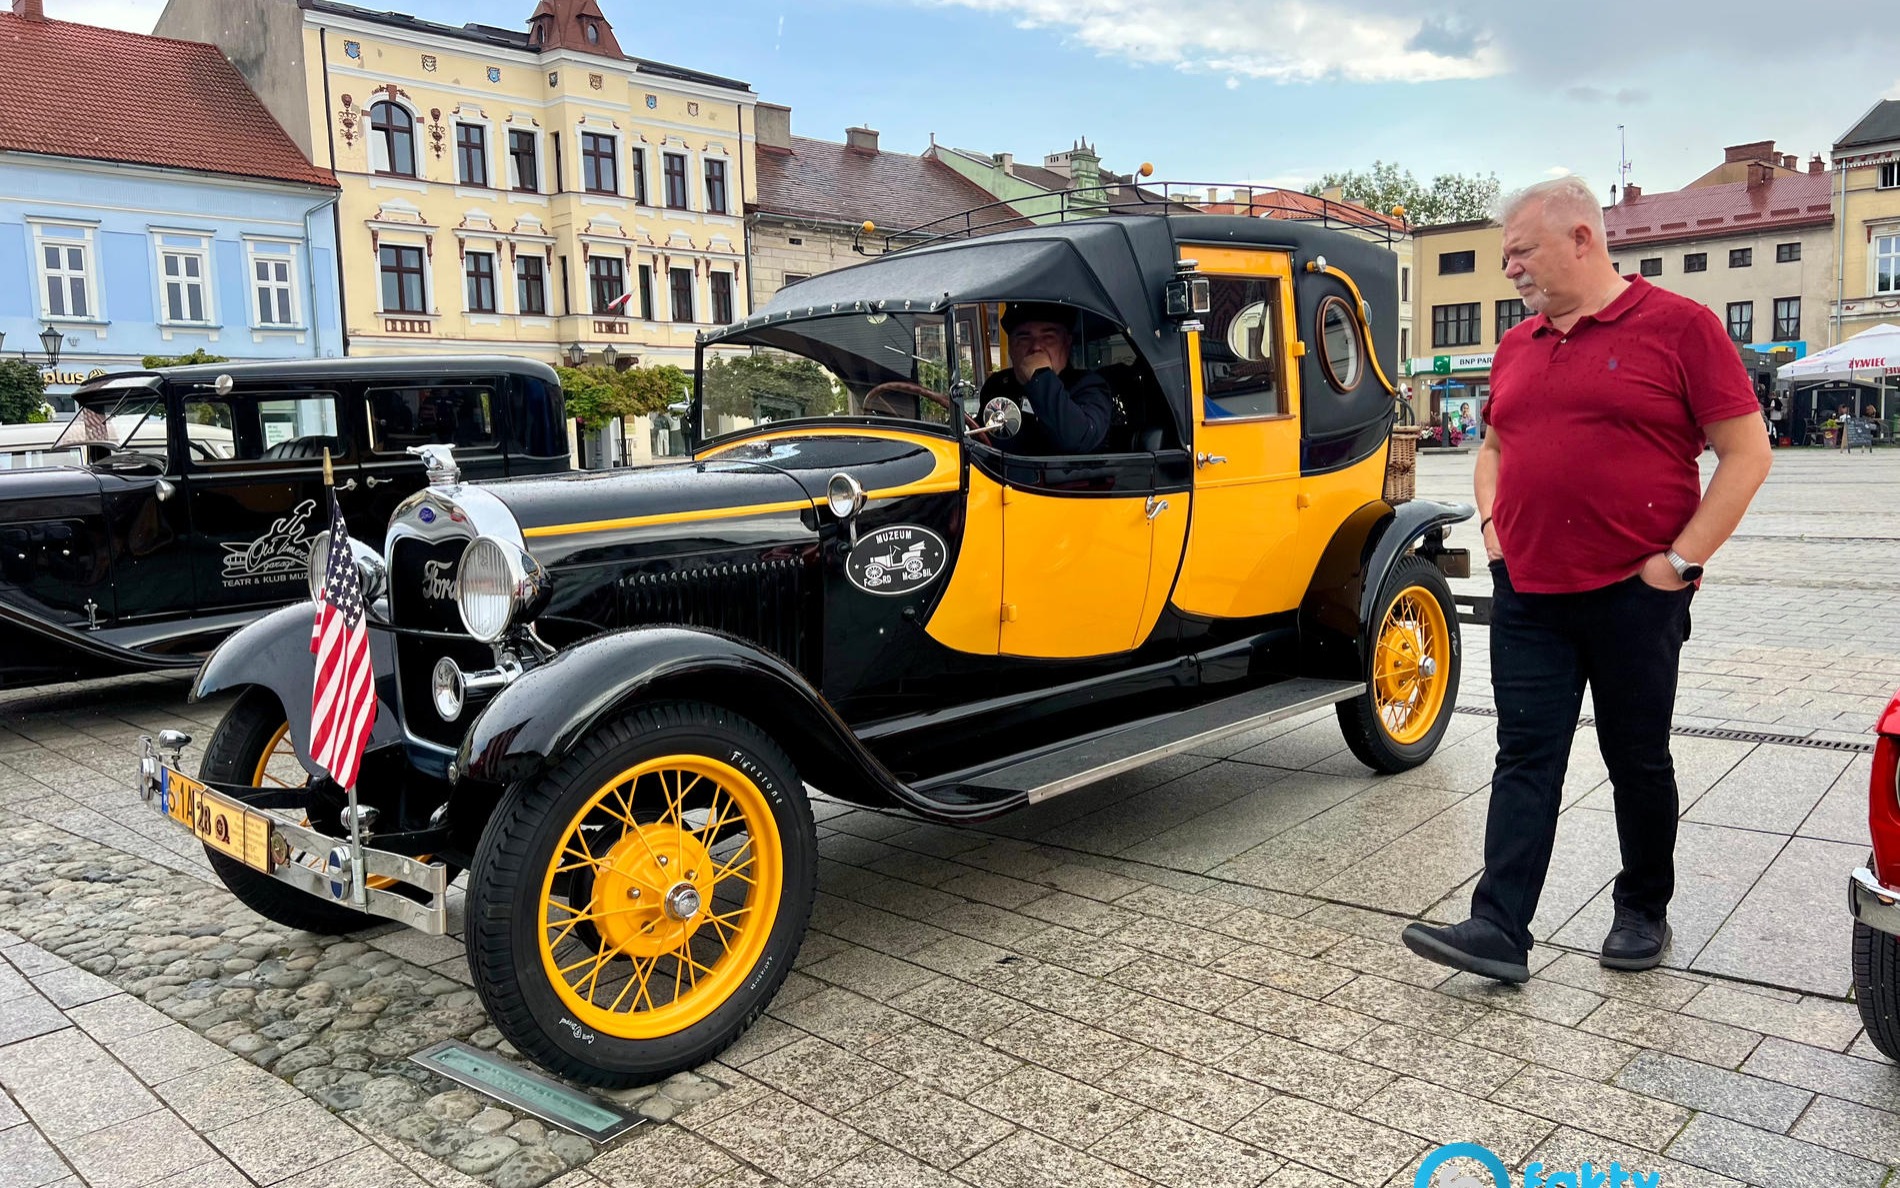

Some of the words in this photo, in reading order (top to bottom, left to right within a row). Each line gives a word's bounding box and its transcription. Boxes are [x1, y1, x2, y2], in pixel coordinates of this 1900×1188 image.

[42, 369, 84, 387] plus
[875, 530, 912, 545] MUZEUM
[249, 540, 275, 567] Old
[263, 560, 296, 573] garage
[222, 578, 252, 588] TEATR
[254, 577, 260, 585] &
[263, 573, 287, 583] KLUB
[289, 572, 309, 580] MUZ
[730, 750, 783, 805] Firestone
[196, 801, 211, 836] 28
